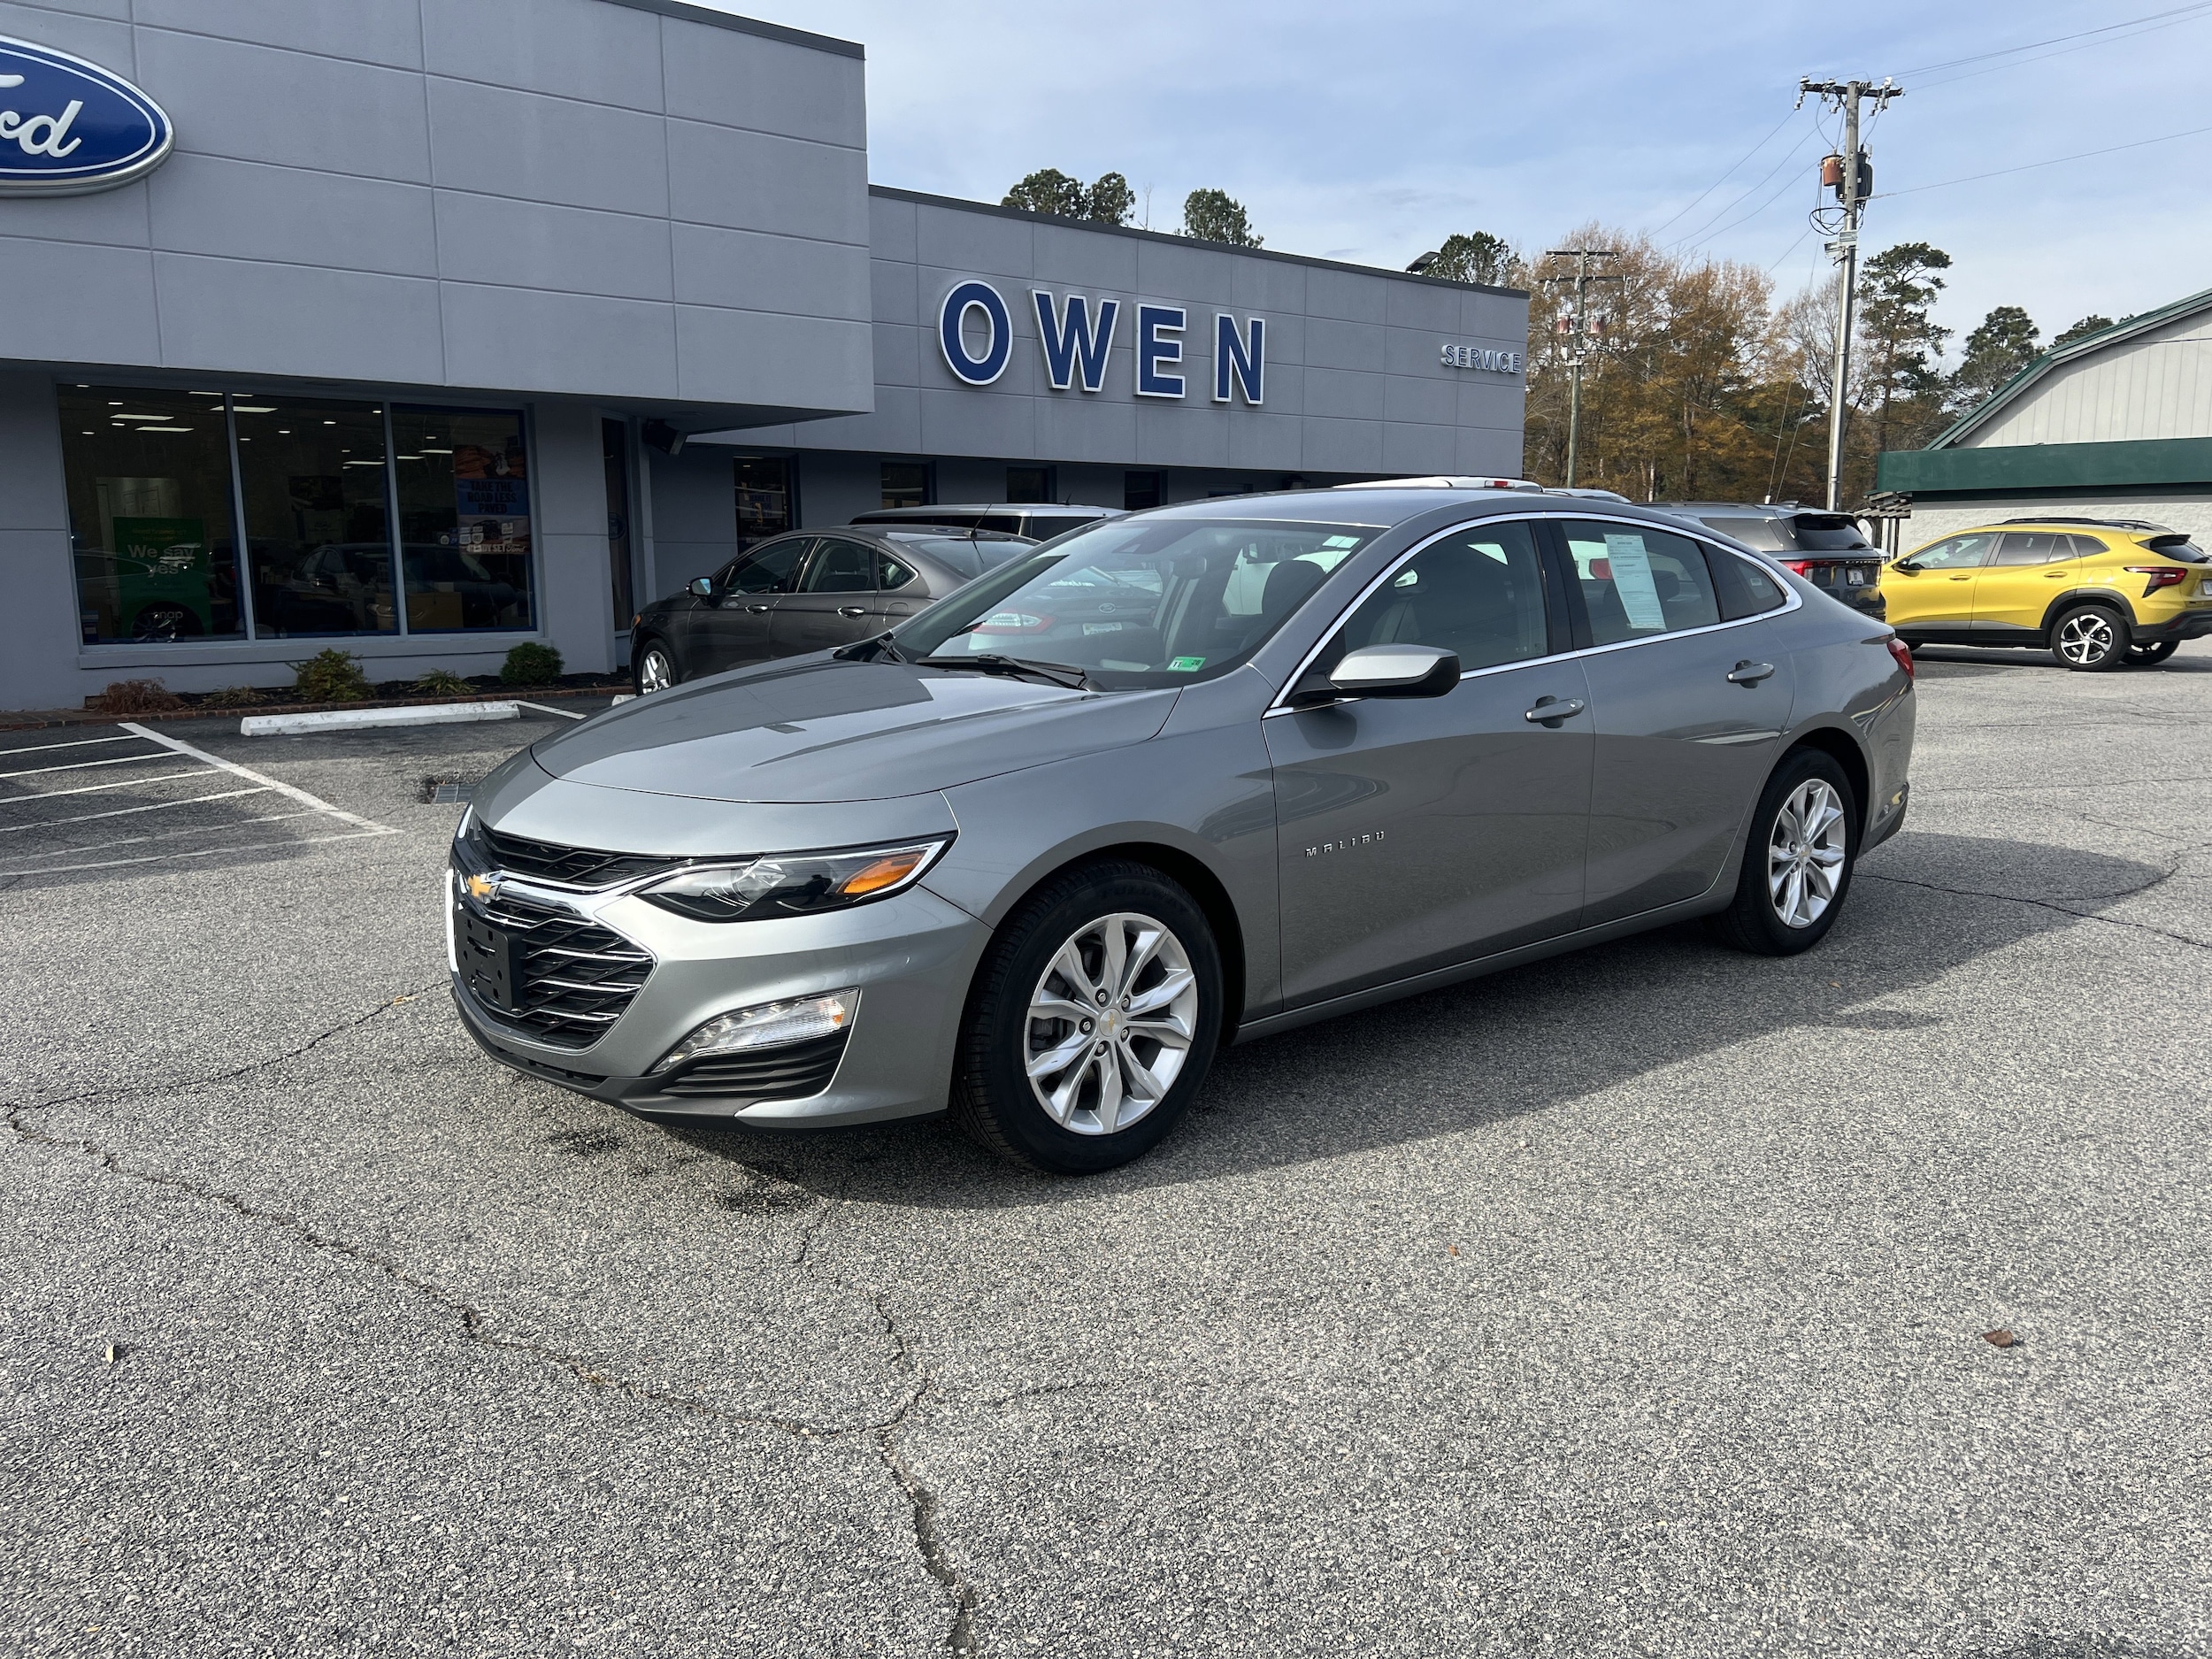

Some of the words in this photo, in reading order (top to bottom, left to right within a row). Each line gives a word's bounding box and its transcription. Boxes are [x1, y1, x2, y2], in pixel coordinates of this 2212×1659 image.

[937, 279, 1266, 405] OWEN
[1440, 344, 1521, 373] SERVICE
[470, 480, 494, 492] TAKE
[495, 481, 512, 492] THE
[467, 492, 494, 503] ROAD
[495, 492, 517, 503] LESS
[479, 503, 507, 513] PAVED
[127, 544, 158, 558] We
[163, 547, 195, 562] say
[147, 565, 179, 578] yes
[1305, 831, 1385, 857] MALIBU
